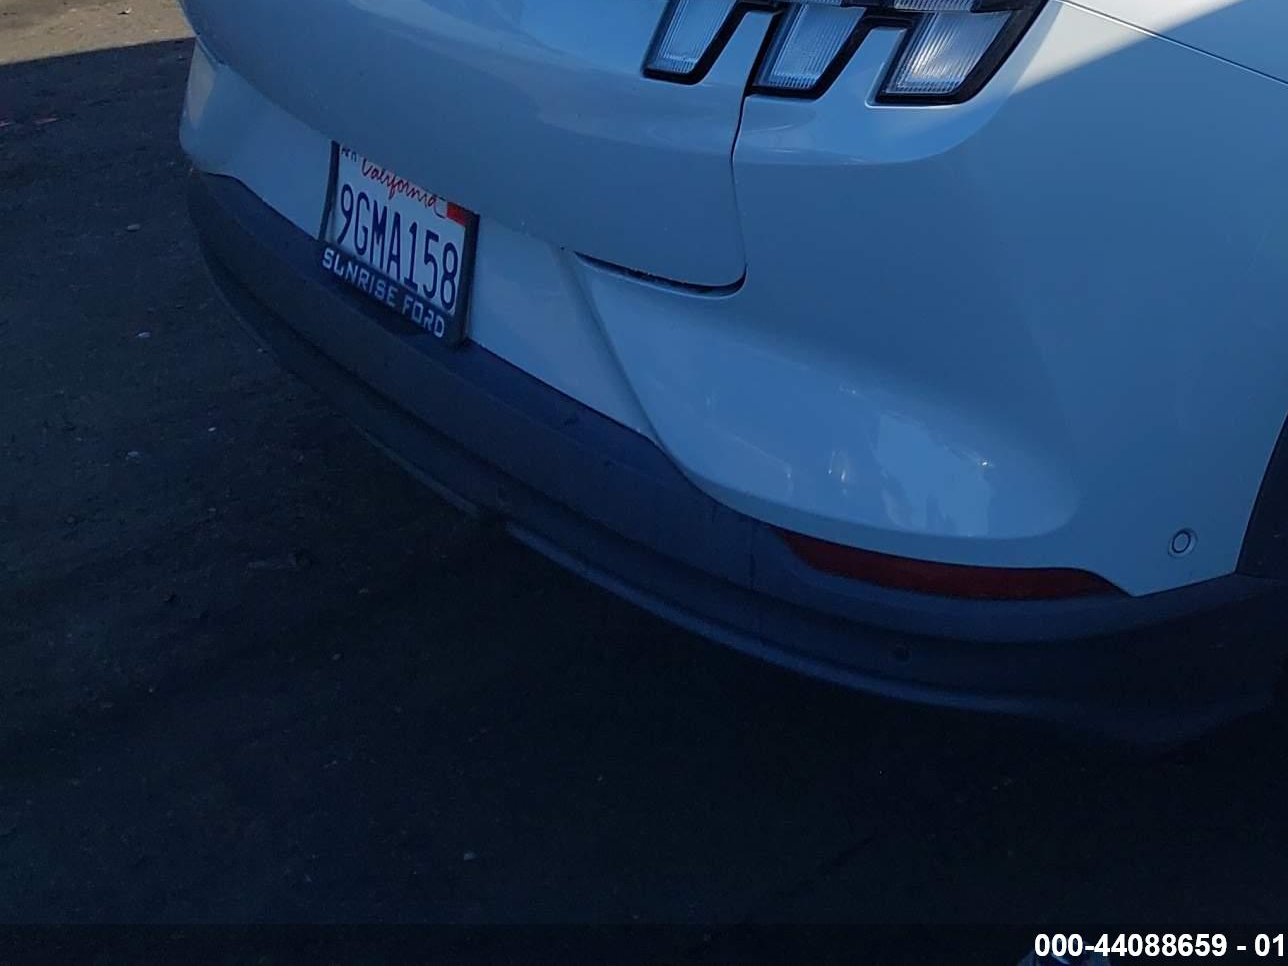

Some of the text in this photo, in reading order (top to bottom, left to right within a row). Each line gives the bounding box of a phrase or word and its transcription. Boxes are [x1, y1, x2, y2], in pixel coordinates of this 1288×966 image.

[321, 247, 446, 338] SUNRISE FORD
[336, 183, 459, 311] 9GMA158
